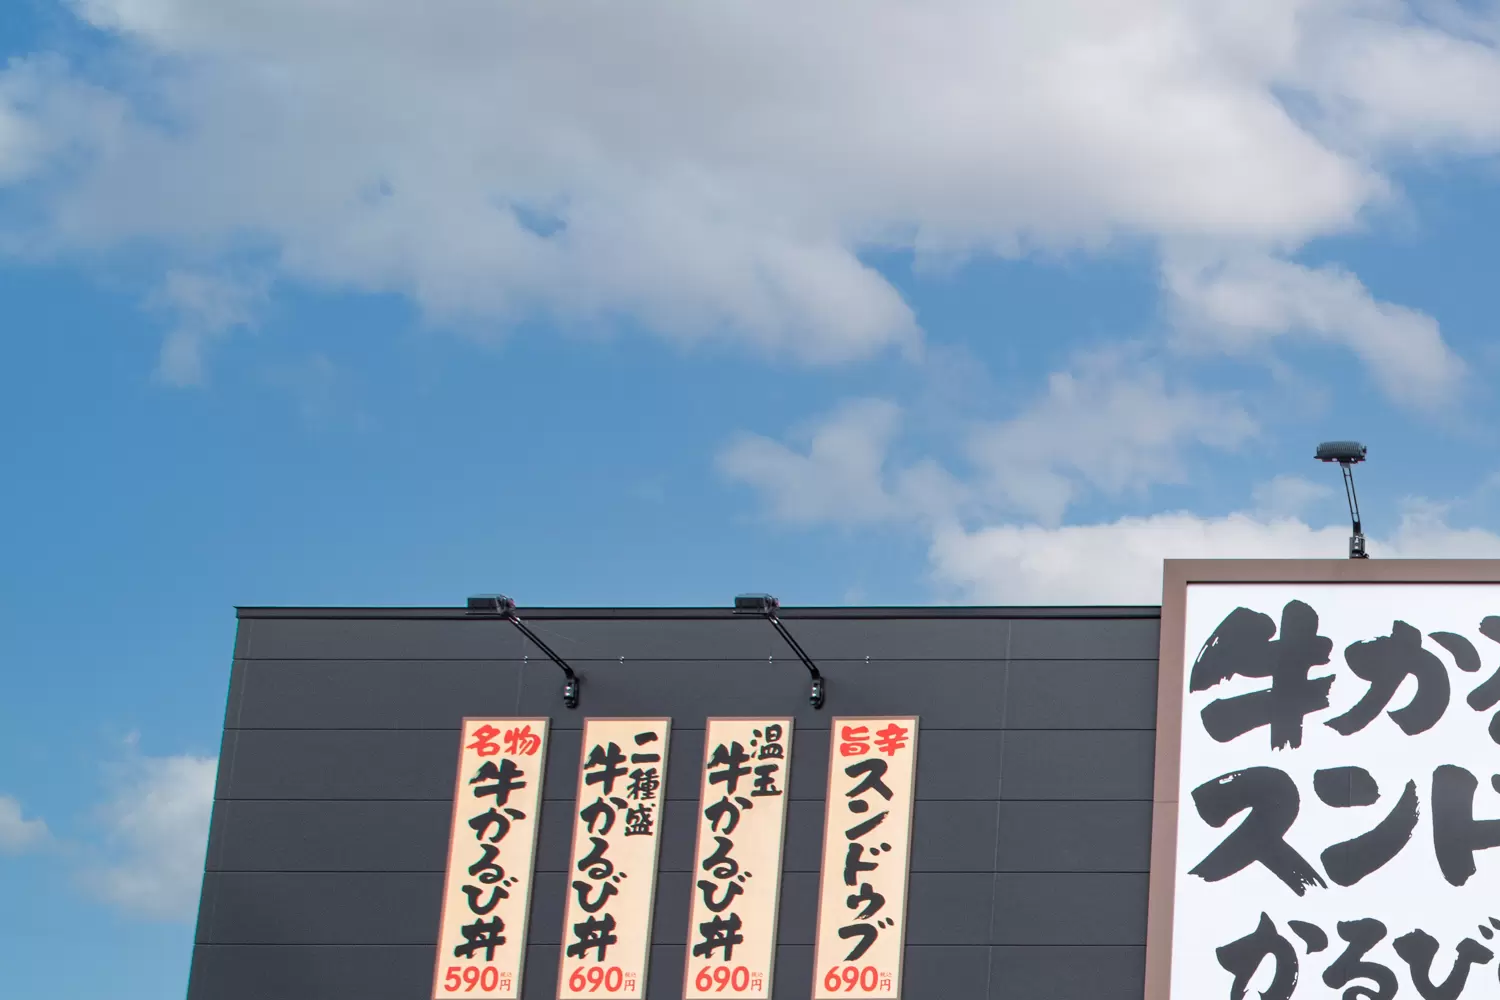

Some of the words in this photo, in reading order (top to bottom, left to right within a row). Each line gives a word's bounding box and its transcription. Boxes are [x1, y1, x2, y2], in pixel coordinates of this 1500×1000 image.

[465, 724, 542, 757] 名物
[623, 730, 661, 837] 二種盛
[750, 724, 785, 797] 温玉
[840, 724, 909, 757] 旨辛
[453, 758, 527, 962] 牛かるび丼
[566, 742, 628, 962] 牛かるび丼
[693, 742, 753, 962] 牛かるび丼
[838, 758, 895, 962] スンドゥブ
